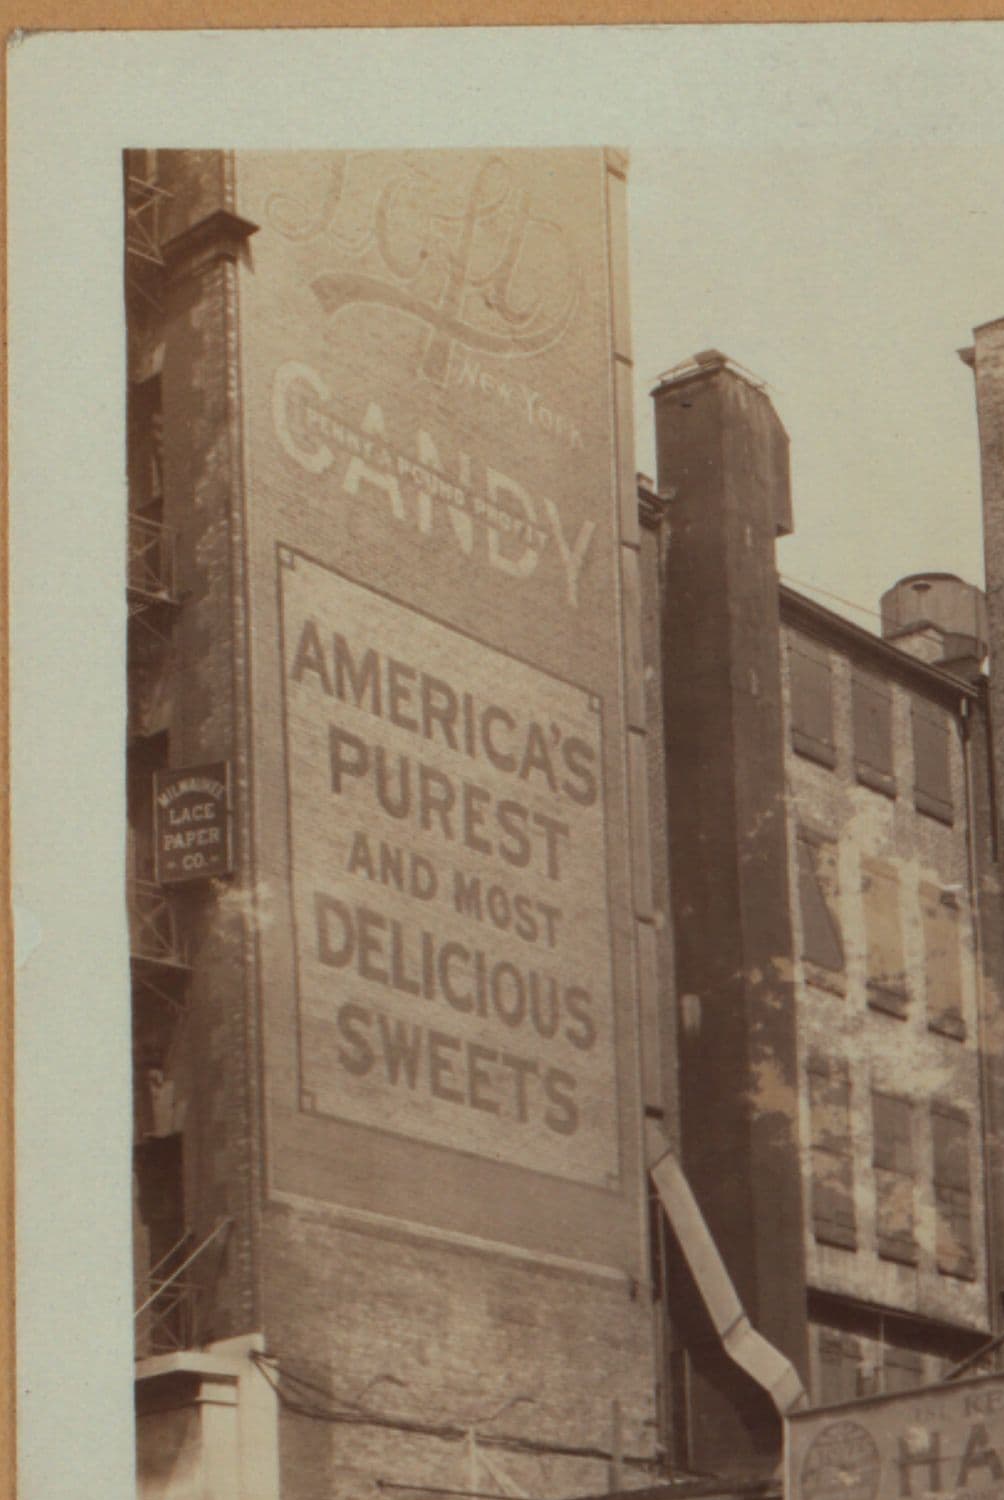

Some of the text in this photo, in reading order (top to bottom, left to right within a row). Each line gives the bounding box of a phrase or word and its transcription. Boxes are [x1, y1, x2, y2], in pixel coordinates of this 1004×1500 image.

[271, 360, 595, 607] CANDY
[289, 618, 599, 807] AMERICA'S
[163, 827, 219, 850] PAPER
[169, 803, 215, 825] LACE
[327, 725, 570, 881] PUREST
[347, 831, 564, 949] AND MOST
[313, 891, 598, 1052] DELICIOUS
[335, 1003, 581, 1137] SWEETS
